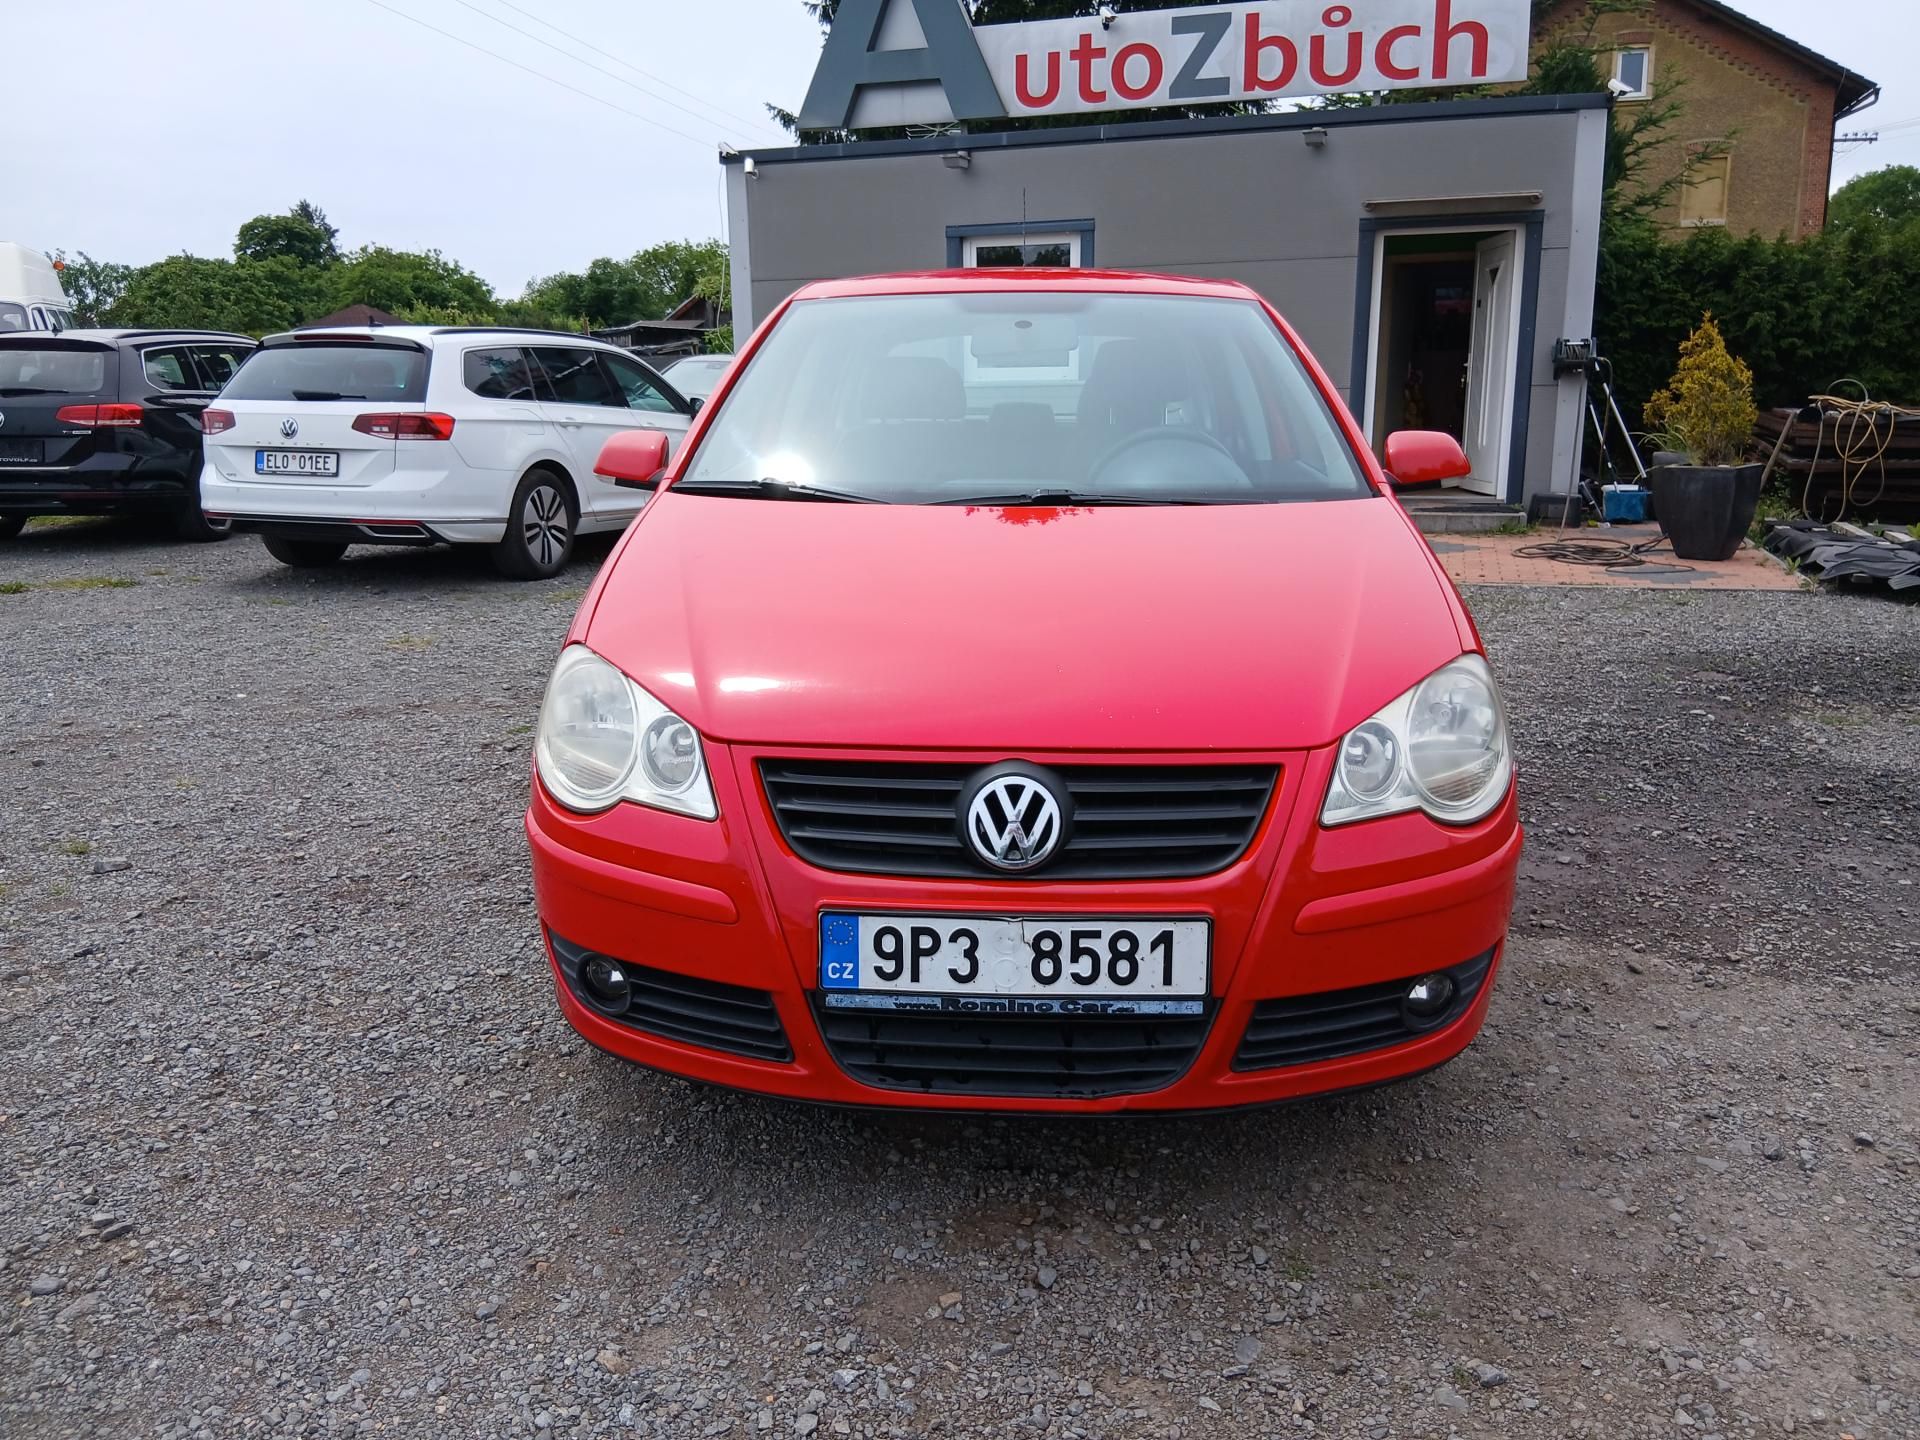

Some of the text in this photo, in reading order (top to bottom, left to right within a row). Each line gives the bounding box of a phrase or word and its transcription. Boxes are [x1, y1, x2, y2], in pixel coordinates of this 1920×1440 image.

[827, 962, 854, 980] CZ
[872, 925, 1174, 987] 9P3 8581
